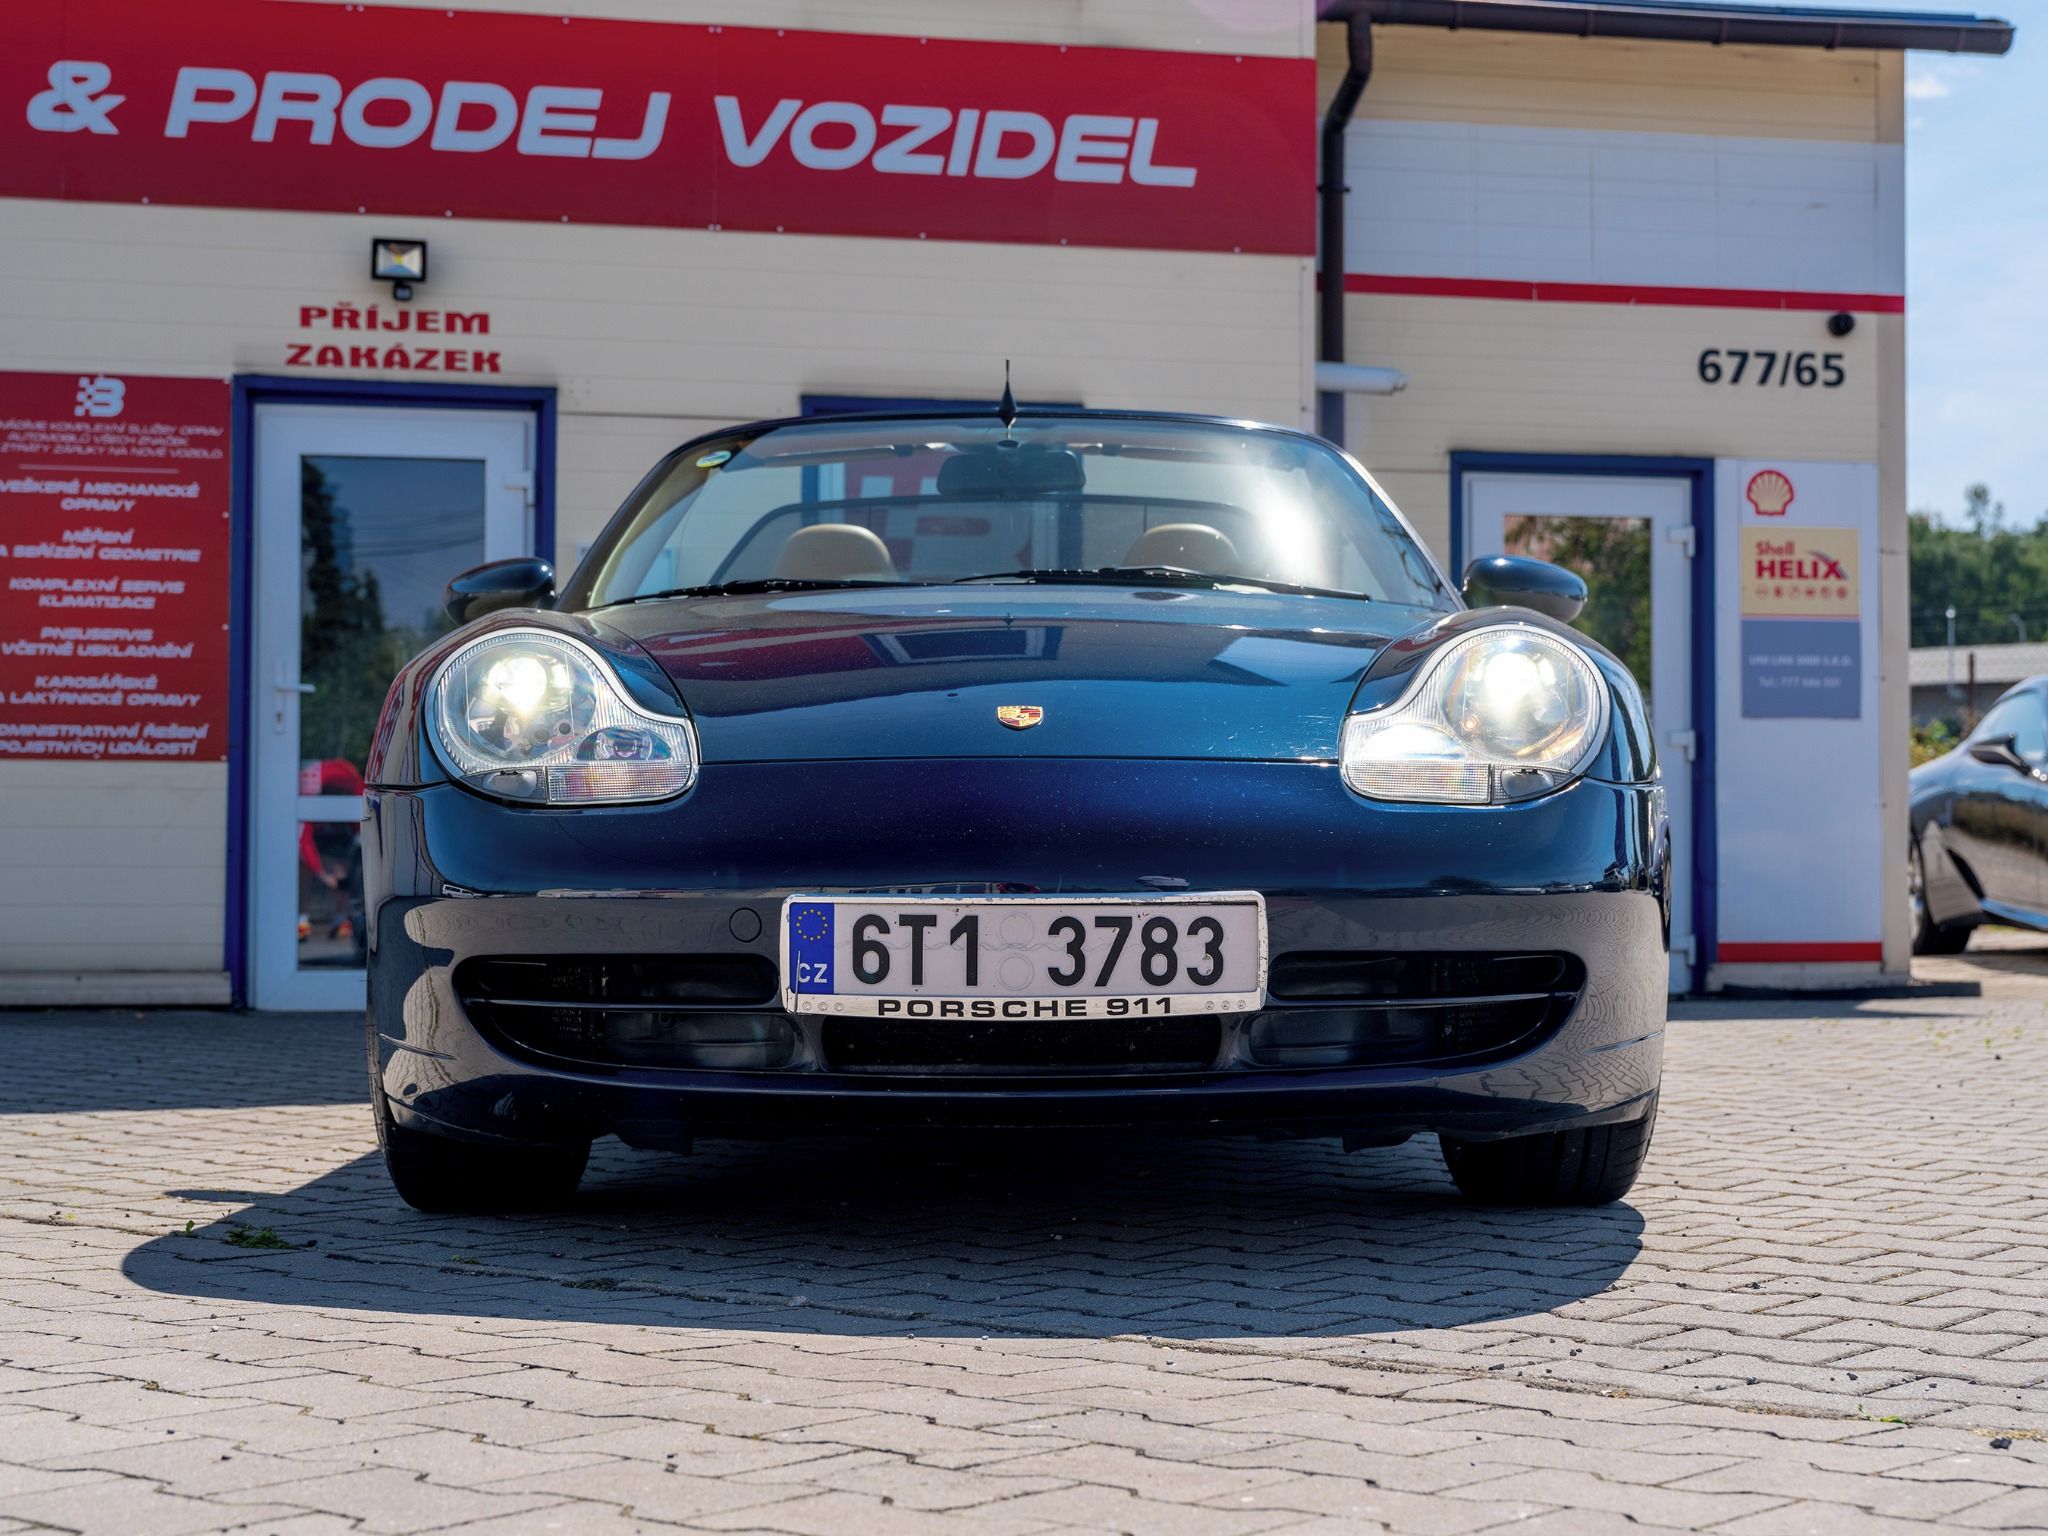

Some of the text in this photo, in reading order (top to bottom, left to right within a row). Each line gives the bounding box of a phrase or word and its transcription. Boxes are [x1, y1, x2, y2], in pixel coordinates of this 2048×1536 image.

[26, 60, 1197, 188] & PRODEJ VOZIDEL
[300, 301, 490, 334] PŘÍJEM
[286, 341, 501, 373] ZAKÁZEK
[1698, 348, 1846, 388] 677/65
[0, 419, 47, 431] ÁDÍME
[0, 477, 200, 498] VEŠKERÉ MECHANICKÉ
[60, 498, 136, 511] OPRAVY
[62, 527, 135, 544] MĚŘENÍ
[13, 542, 96, 559] SEŘÍZENÍ
[98, 547, 201, 562] GEOMETRIE
[1755, 540, 1795, 556] Shell
[1756, 560, 1846, 580] HELIX
[9, 576, 185, 594] KOMPLEXNÍ SERVIS
[38, 595, 156, 609] KLIMATIZACE
[40, 627, 154, 641] PNEUSERVIS
[1, 640, 194, 658] VČETNĚ USKLADNĚNÍ
[35, 673, 158, 690] KAROSÁŘSKÉ
[9, 689, 124, 705] LAKÝRNICKÉ
[127, 693, 201, 707] OPRAVY
[0, 722, 209, 740] DMINISTRATIVNÍ ŘEŠENÍ
[108, 738, 198, 755] UDÁLOSTÍ
[851, 913, 1225, 988] 6T1 3783
[797, 963, 828, 984] CZ
[878, 997, 1172, 1018] PORSCHE 911
